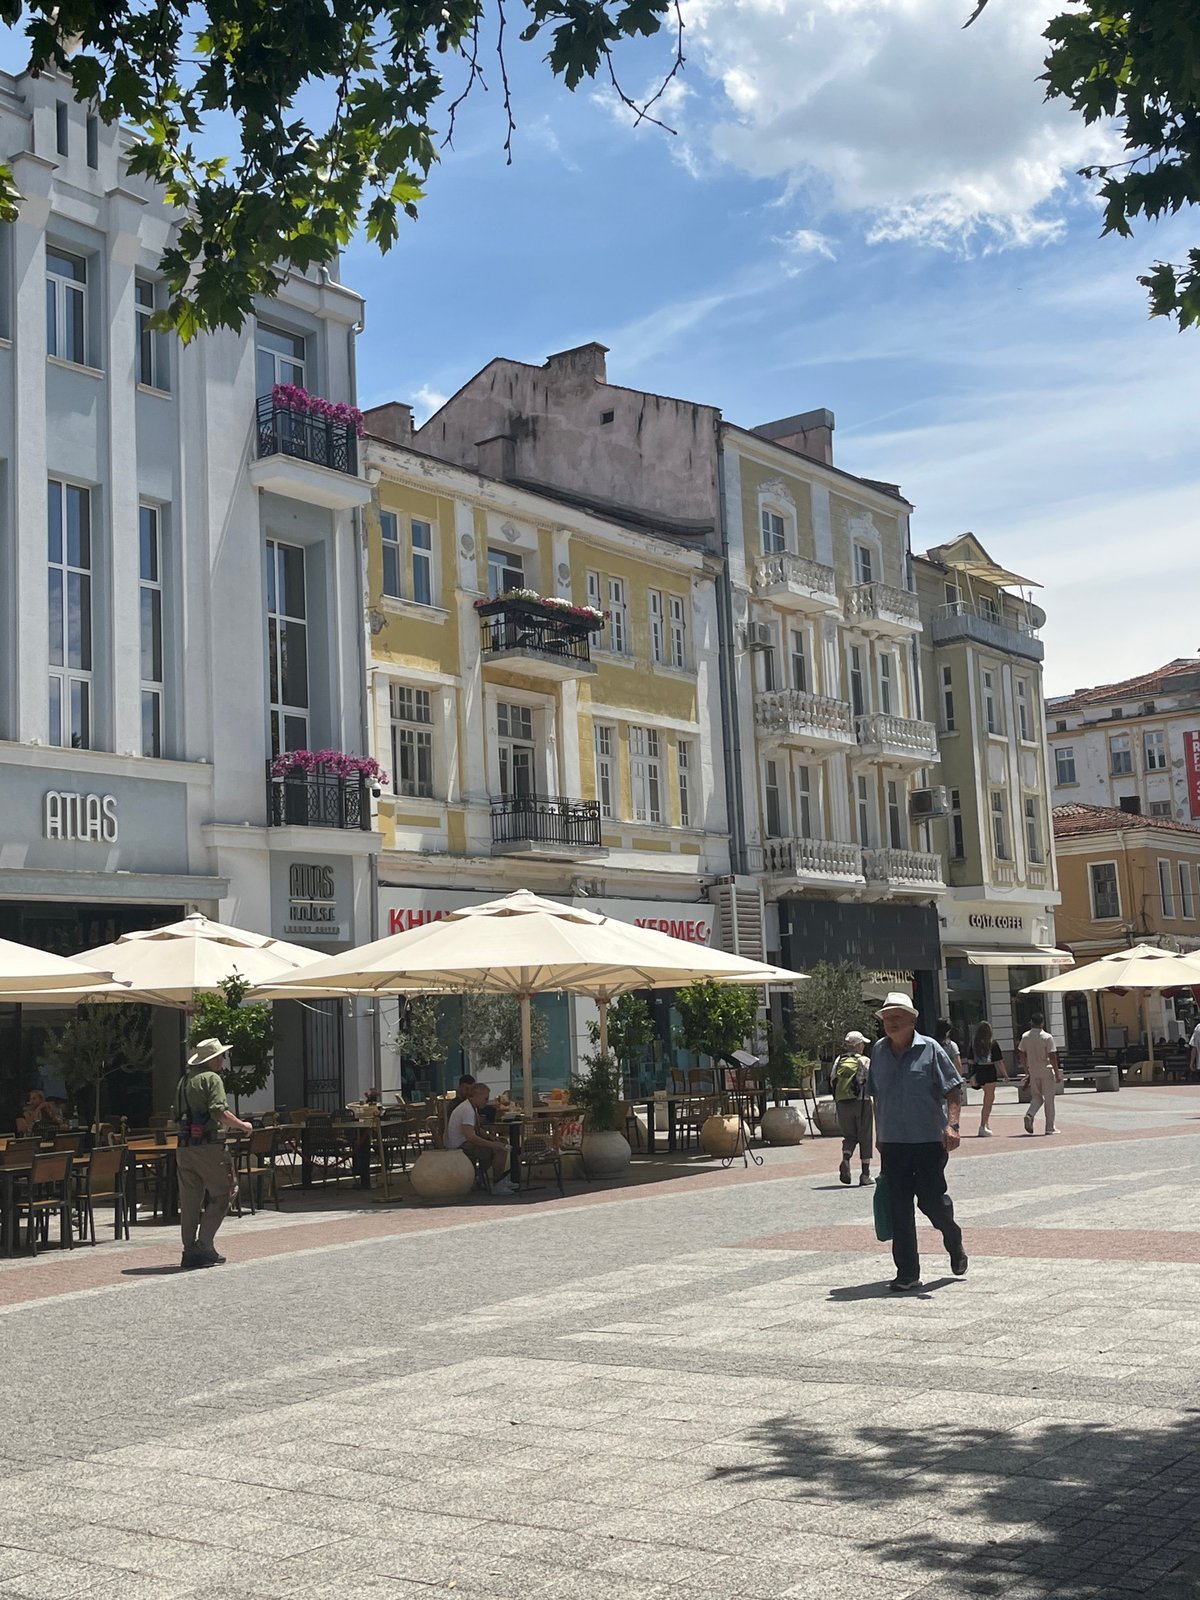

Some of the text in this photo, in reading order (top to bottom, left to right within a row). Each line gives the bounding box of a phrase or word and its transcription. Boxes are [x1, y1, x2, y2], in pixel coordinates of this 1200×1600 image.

[43, 790, 118, 843] ATLAS
[289, 864, 335, 898] ATLAS
[290, 905, 336, 921] HOUSE
[388, 908, 451, 936] КН
[968, 914, 995, 929] COSTA
